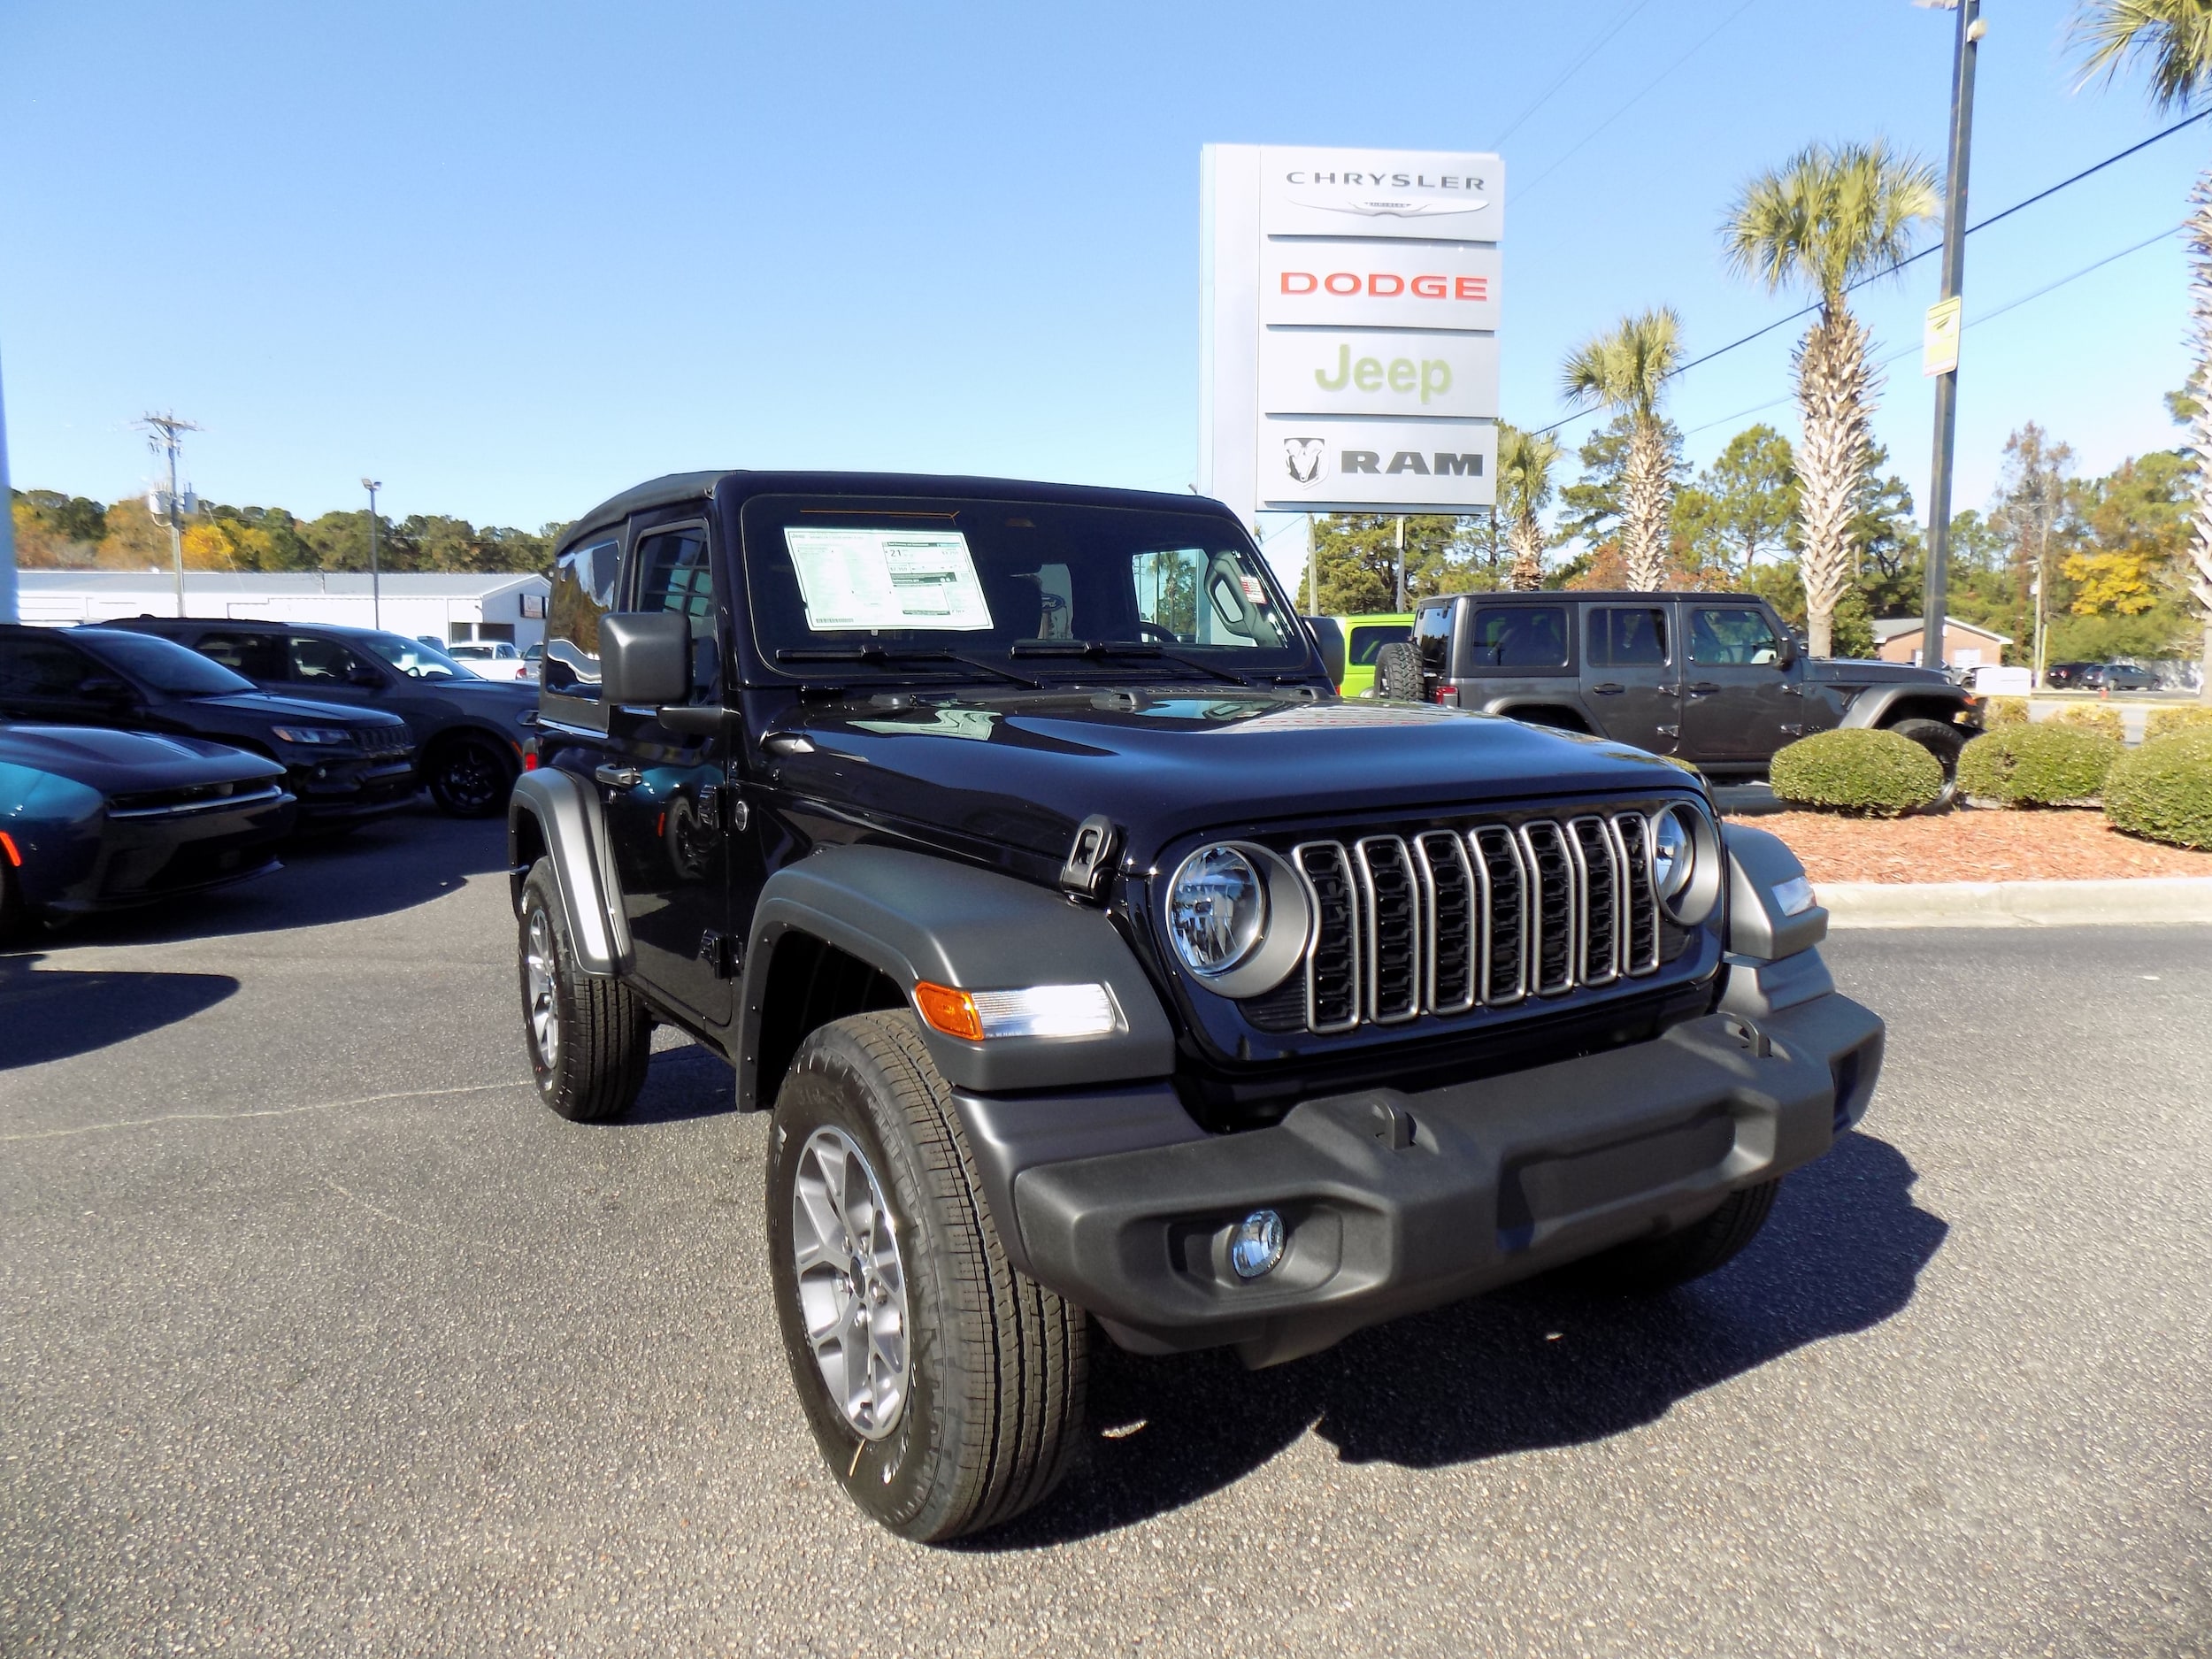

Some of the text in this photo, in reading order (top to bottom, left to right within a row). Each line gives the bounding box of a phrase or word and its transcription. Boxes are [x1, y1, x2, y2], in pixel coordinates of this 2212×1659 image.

[1286, 172, 1485, 191] CHRYSLER
[1281, 273, 1487, 302] DODGE
[1315, 344, 1453, 403] Jeep
[1341, 450, 1483, 477] RAM
